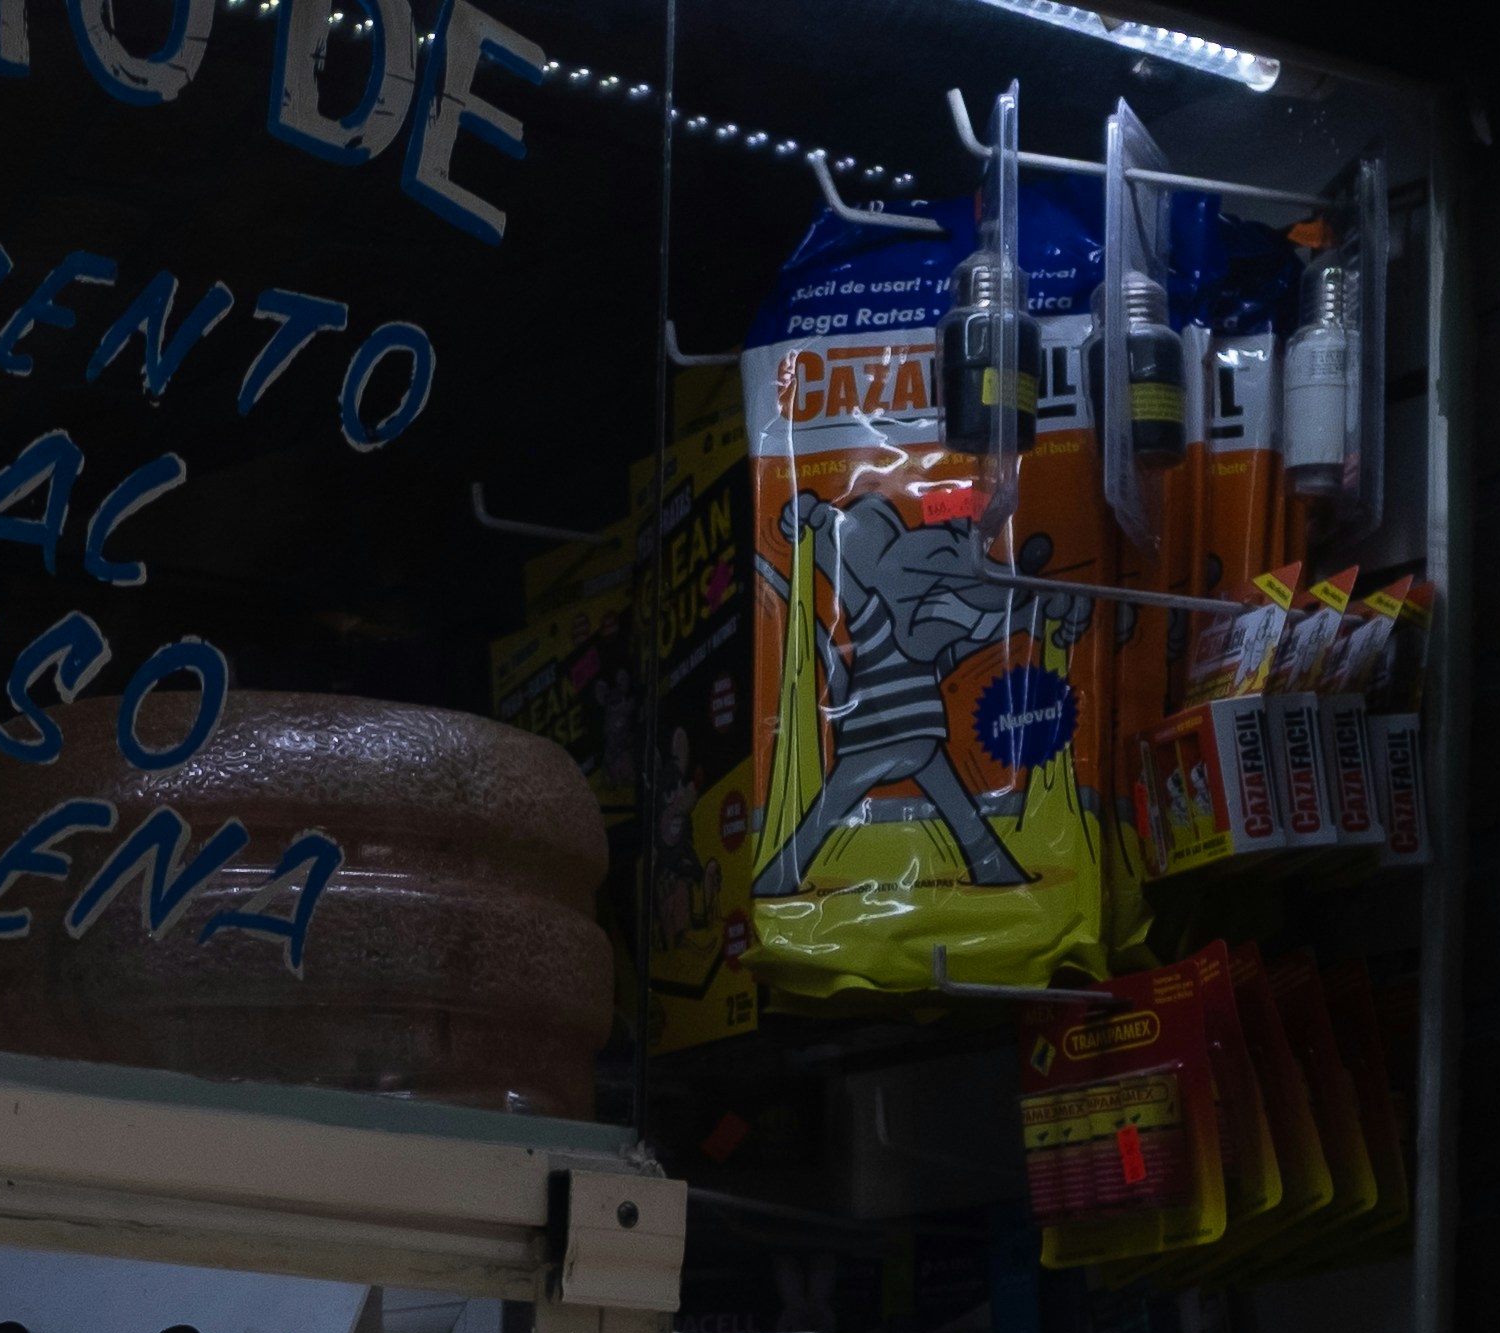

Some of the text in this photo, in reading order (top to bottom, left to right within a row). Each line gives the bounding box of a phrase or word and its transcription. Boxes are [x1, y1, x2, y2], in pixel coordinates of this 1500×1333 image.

[840, 280, 866, 294] de
[870, 277, 921, 292] usar!
[787, 313, 848, 335] Pega
[855, 307, 926, 326] Ratas
[992, 700, 1065, 738] ¡Nueva!
[1236, 709, 1274, 838] CAZAFACIL
[1284, 706, 1320, 833] CAZAFACIL
[1070, 1019, 1152, 1052] TRAMPAMEX
